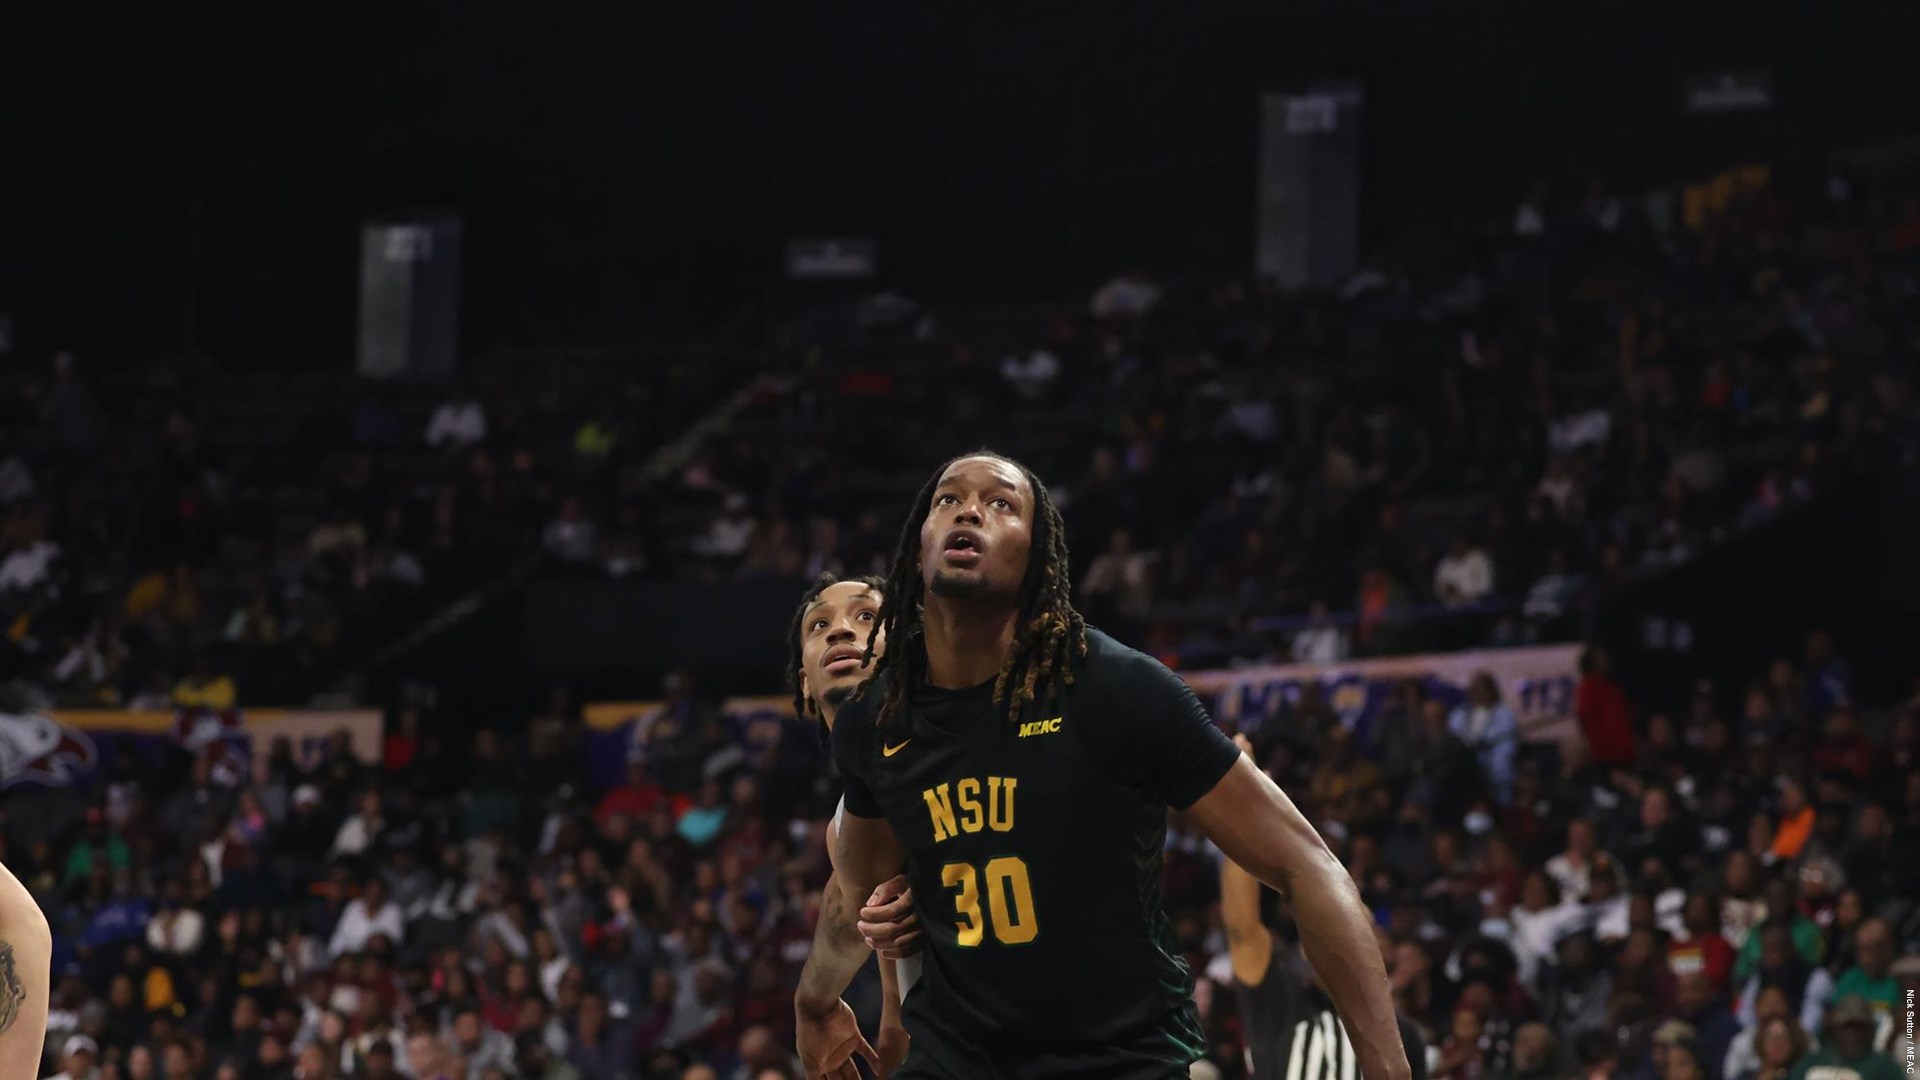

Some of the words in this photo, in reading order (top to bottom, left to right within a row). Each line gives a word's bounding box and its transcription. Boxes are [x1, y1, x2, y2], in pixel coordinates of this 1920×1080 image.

[1019, 717, 1063, 737] MEAC
[923, 776, 1018, 843] NSU
[941, 856, 1039, 947] 30
